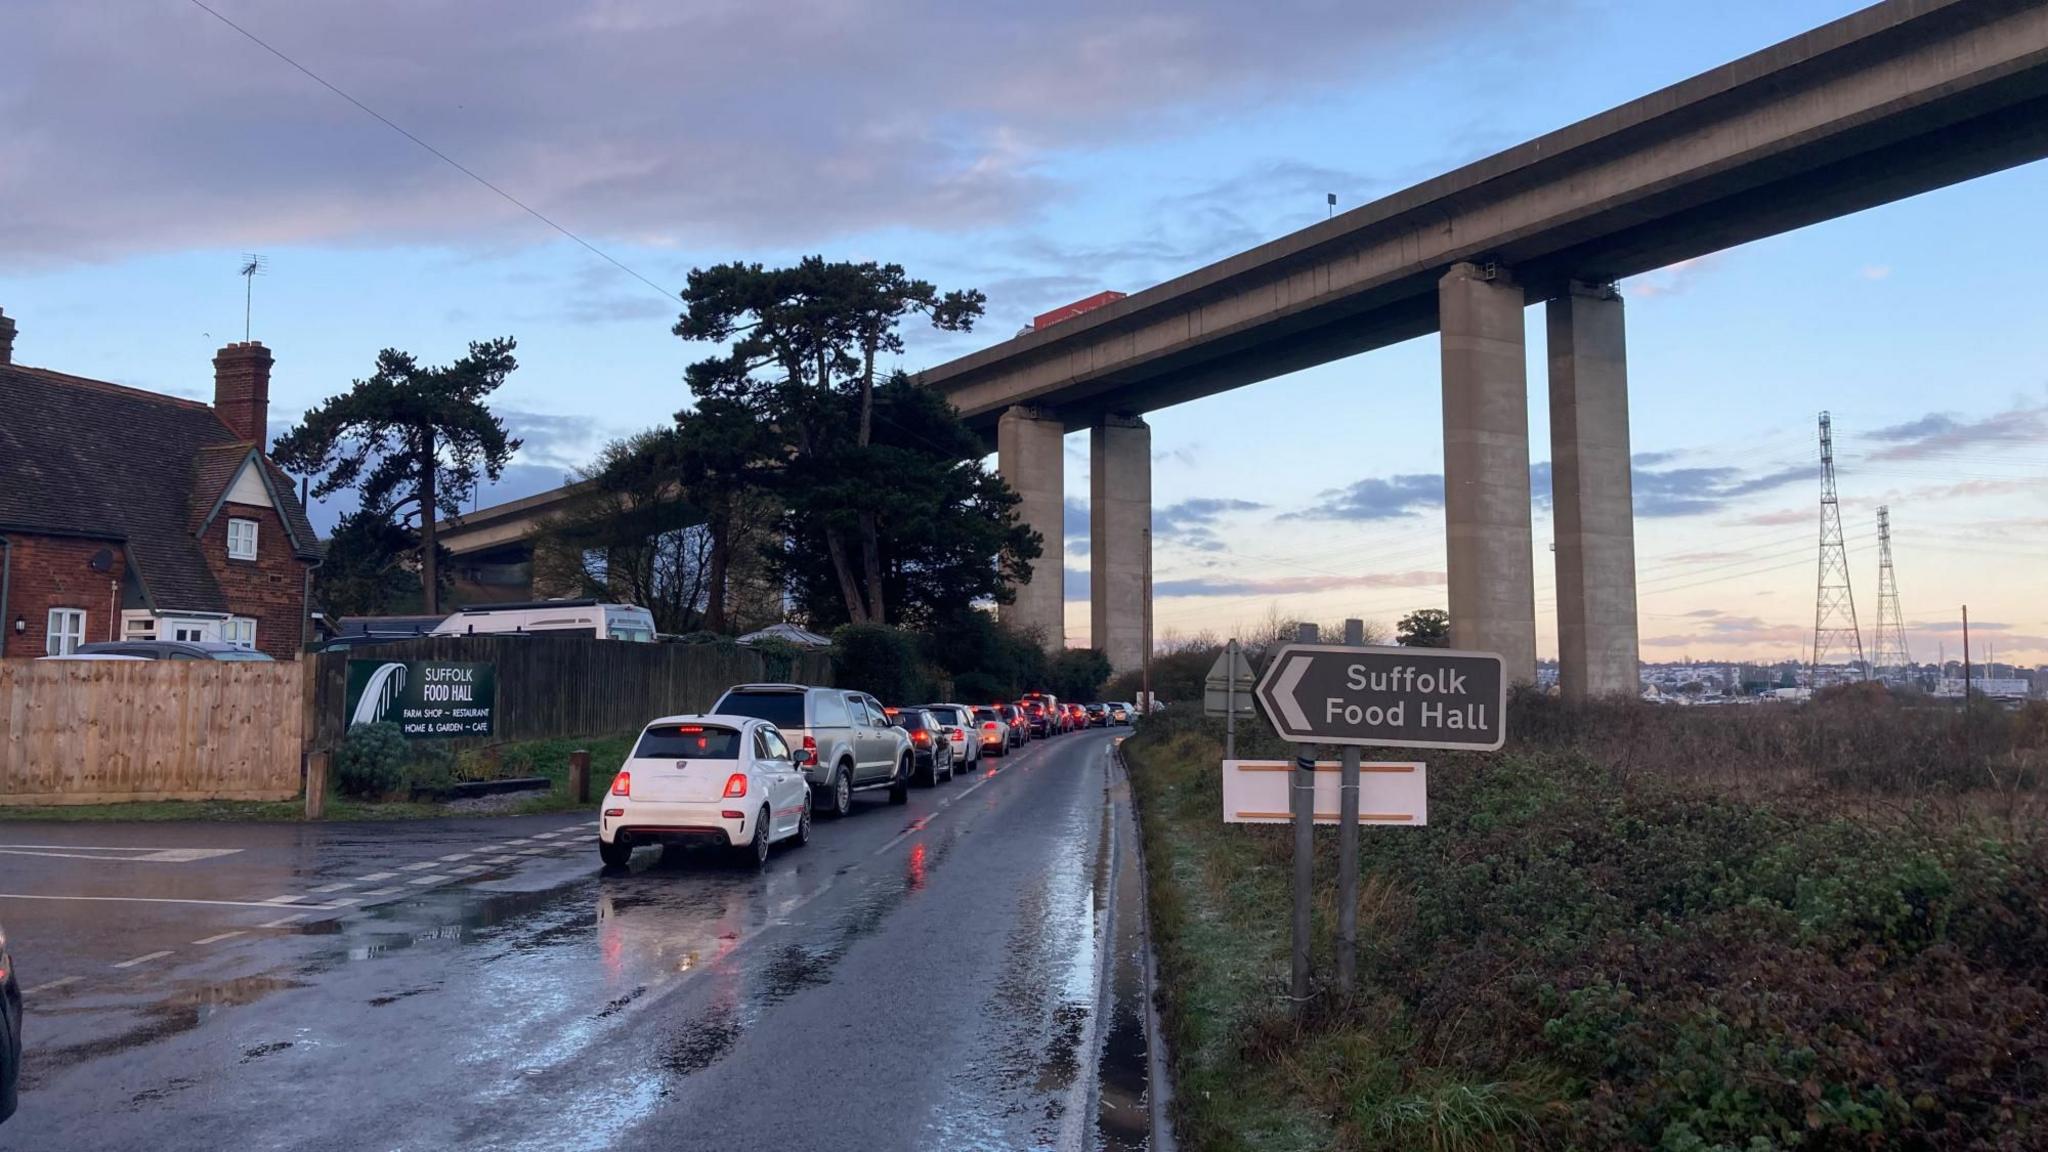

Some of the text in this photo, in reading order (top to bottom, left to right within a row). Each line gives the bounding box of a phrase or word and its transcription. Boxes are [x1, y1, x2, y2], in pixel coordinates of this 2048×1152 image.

[425, 667, 473, 681] SUFFOLK
[1346, 664, 1467, 694] Suffolk
[424, 685, 473, 701] FOOD HALL
[403, 709, 422, 718] FARM
[424, 709, 443, 718] SHOP
[452, 708, 490, 717] RESTAURANT
[1326, 697, 1488, 730] Food Hall
[405, 724, 426, 733] HOME
[428, 723, 434, 732] &
[436, 723, 463, 732] GARDEN
